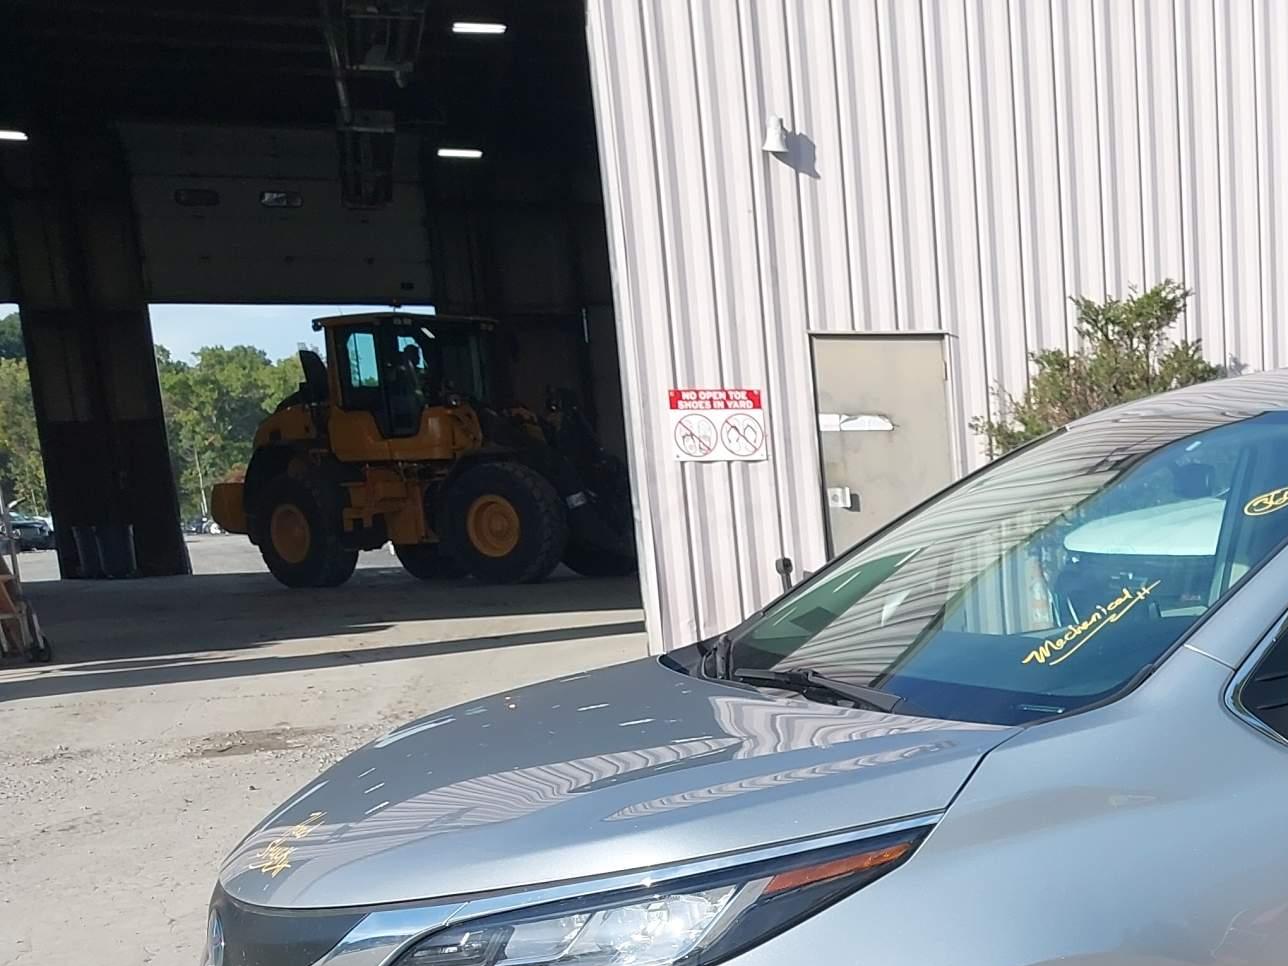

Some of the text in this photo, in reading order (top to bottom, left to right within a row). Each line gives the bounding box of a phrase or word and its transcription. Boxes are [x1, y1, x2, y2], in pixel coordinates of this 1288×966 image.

[681, 390, 749, 400] NO OPEN TOE
[678, 400, 753, 409] SHOES IN YARD
